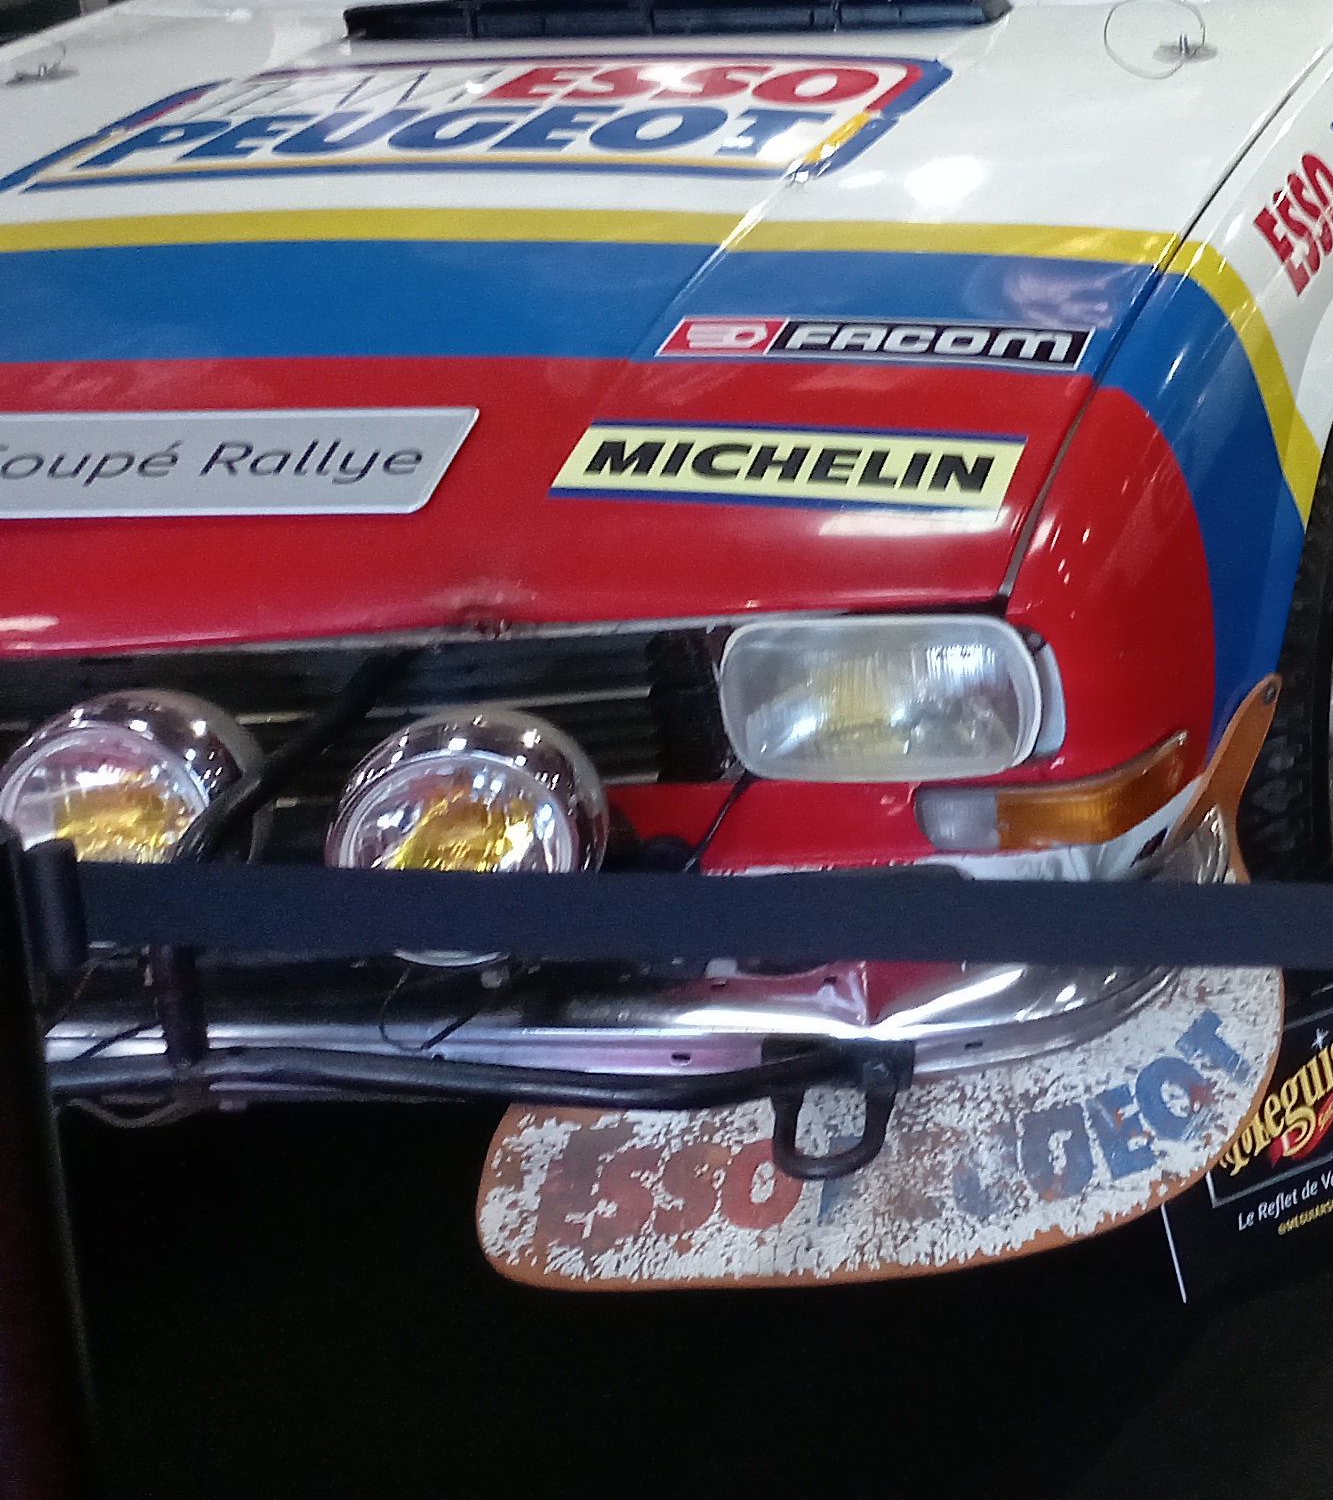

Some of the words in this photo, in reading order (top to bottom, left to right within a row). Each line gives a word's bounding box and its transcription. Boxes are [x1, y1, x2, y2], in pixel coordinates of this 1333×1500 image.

[478, 65, 879, 105] ESSO
[77, 104, 835, 168] PEUGEOT
[787, 322, 1074, 362] FACOM
[0, 438, 184, 488] oupé
[199, 437, 424, 486] Rallye
[582, 438, 995, 494] MICHELIN
[1238, 1210, 1255, 1232] Le
[1257, 1188, 1299, 1222] Reflet
[1301, 1179, 1319, 1201] de
